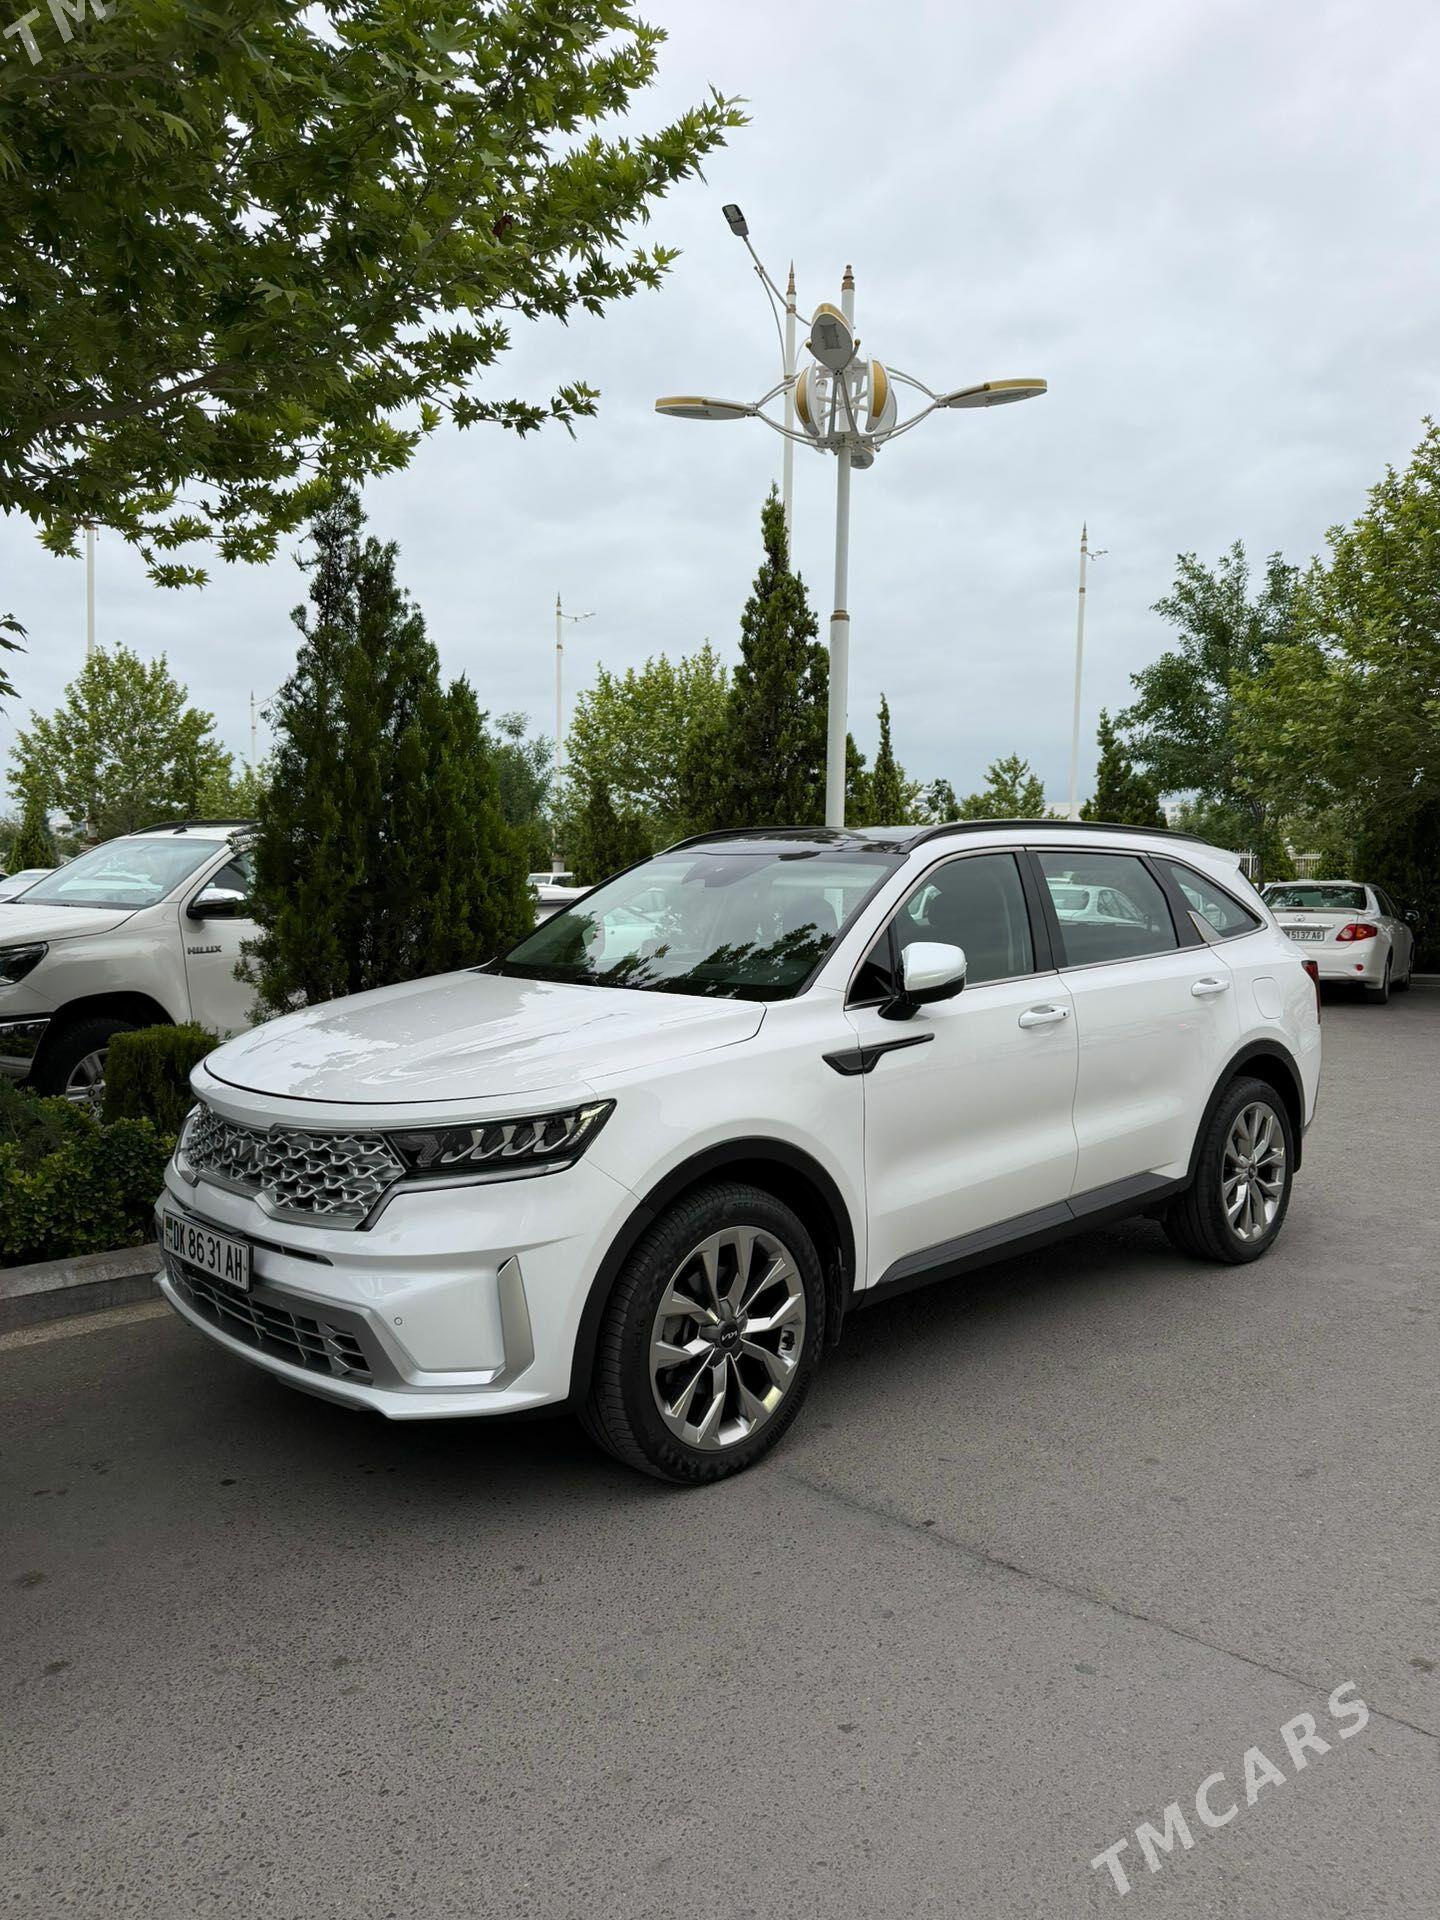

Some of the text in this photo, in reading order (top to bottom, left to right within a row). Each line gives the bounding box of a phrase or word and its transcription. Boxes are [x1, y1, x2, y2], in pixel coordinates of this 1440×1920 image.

[187, 945, 222, 955] HILUX
[173, 1220, 186, 1255] DK
[225, 1244, 243, 1283] AH
